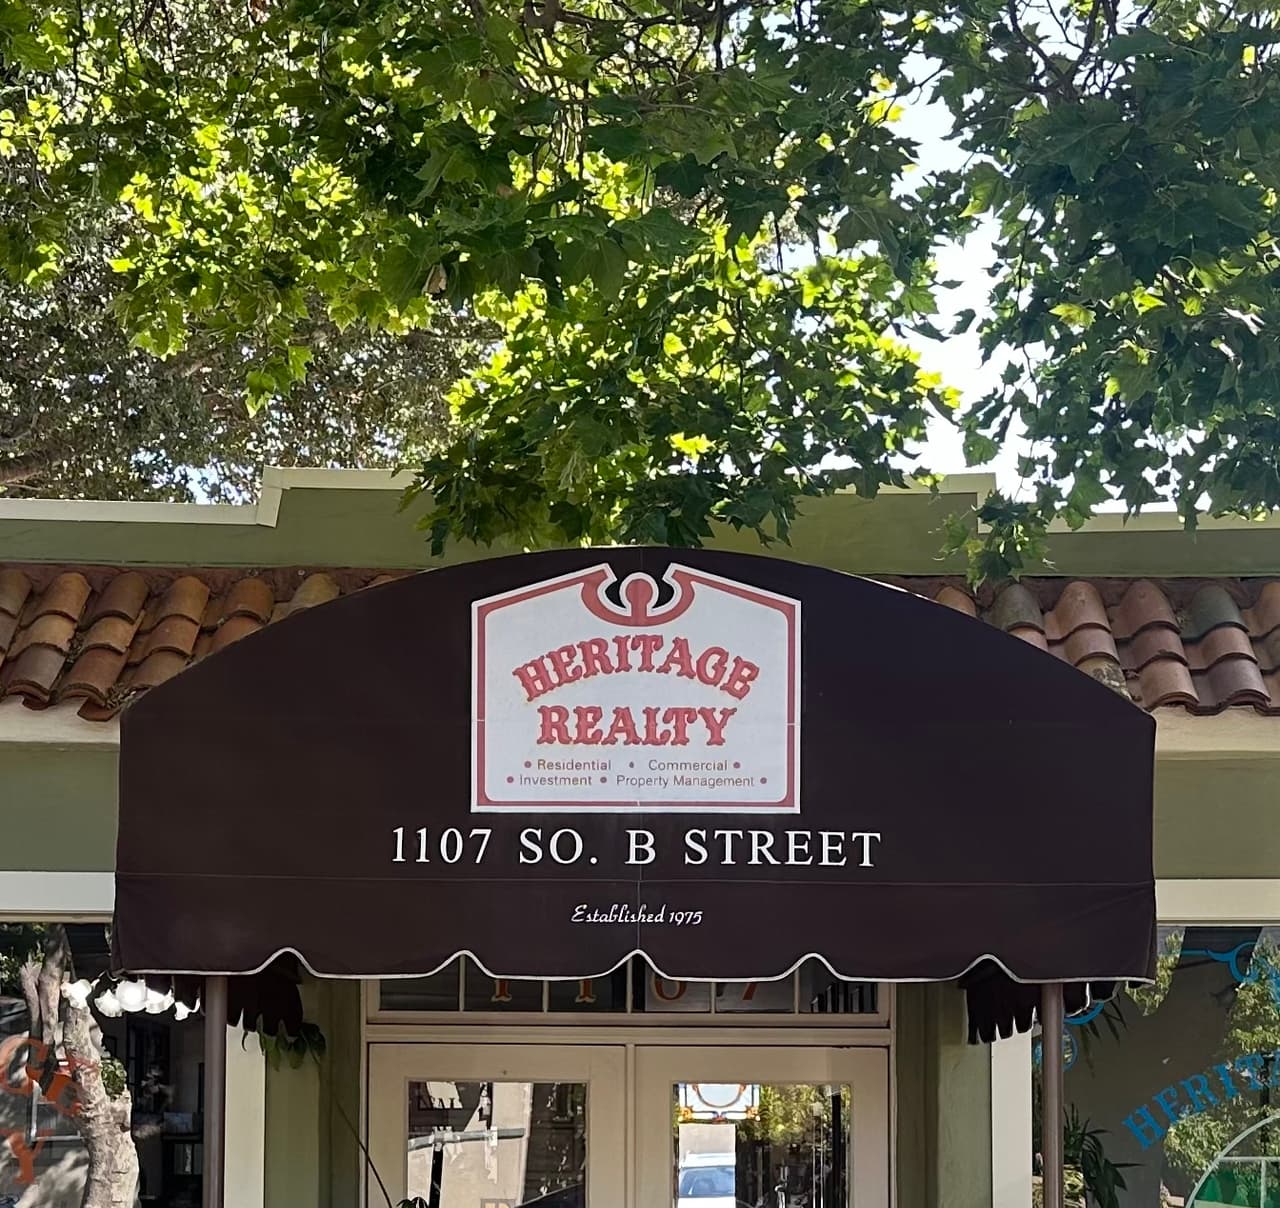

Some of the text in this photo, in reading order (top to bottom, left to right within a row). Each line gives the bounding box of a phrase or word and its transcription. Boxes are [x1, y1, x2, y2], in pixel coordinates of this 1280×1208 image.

[512, 633, 760, 702] HERITAGE
[536, 705, 738, 746] REALTY
[537, 758, 728, 771] Residential Commercial
[519, 774, 755, 789] Investment Property Management
[391, 826, 882, 868] 1107 SO. B STREET
[570, 903, 704, 926] Established 1975
